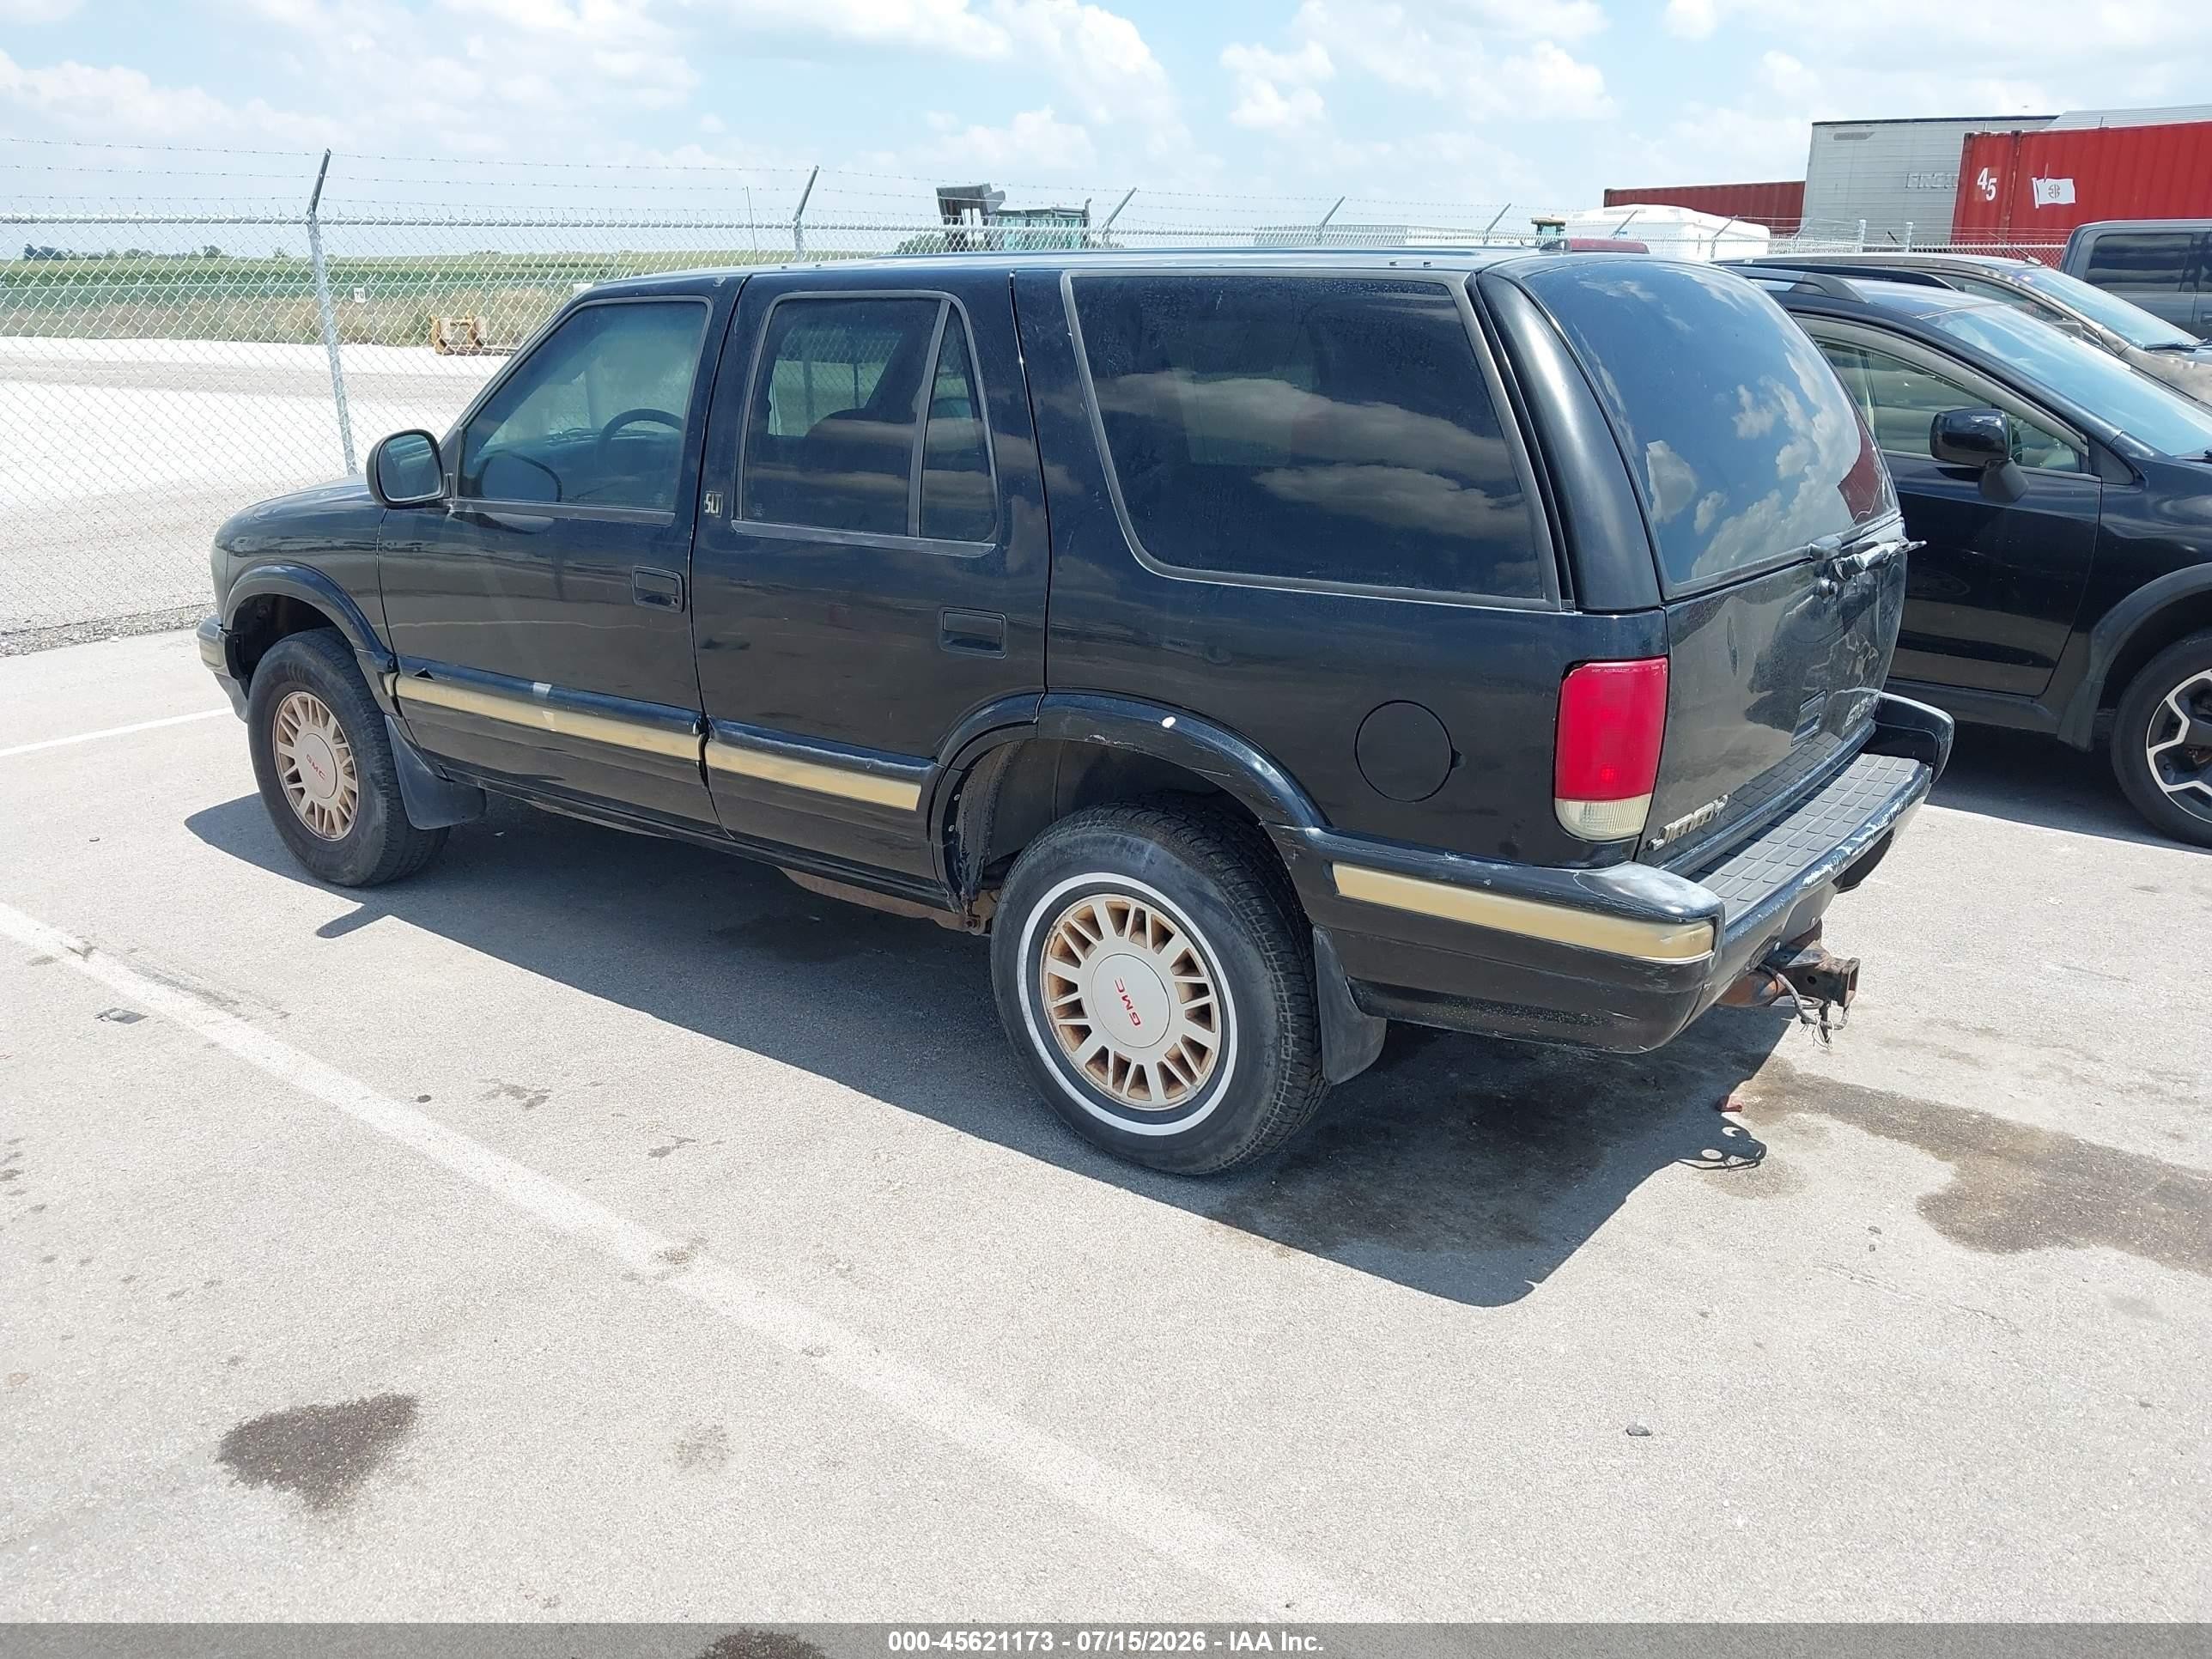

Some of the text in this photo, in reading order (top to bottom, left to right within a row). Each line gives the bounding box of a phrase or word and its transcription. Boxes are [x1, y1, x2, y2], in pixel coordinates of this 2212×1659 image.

[1977, 167, 1997, 201] 45
[704, 493, 722, 514] SLT
[307, 754, 325, 780] GMC
[1115, 978, 1140, 1026] GMC
